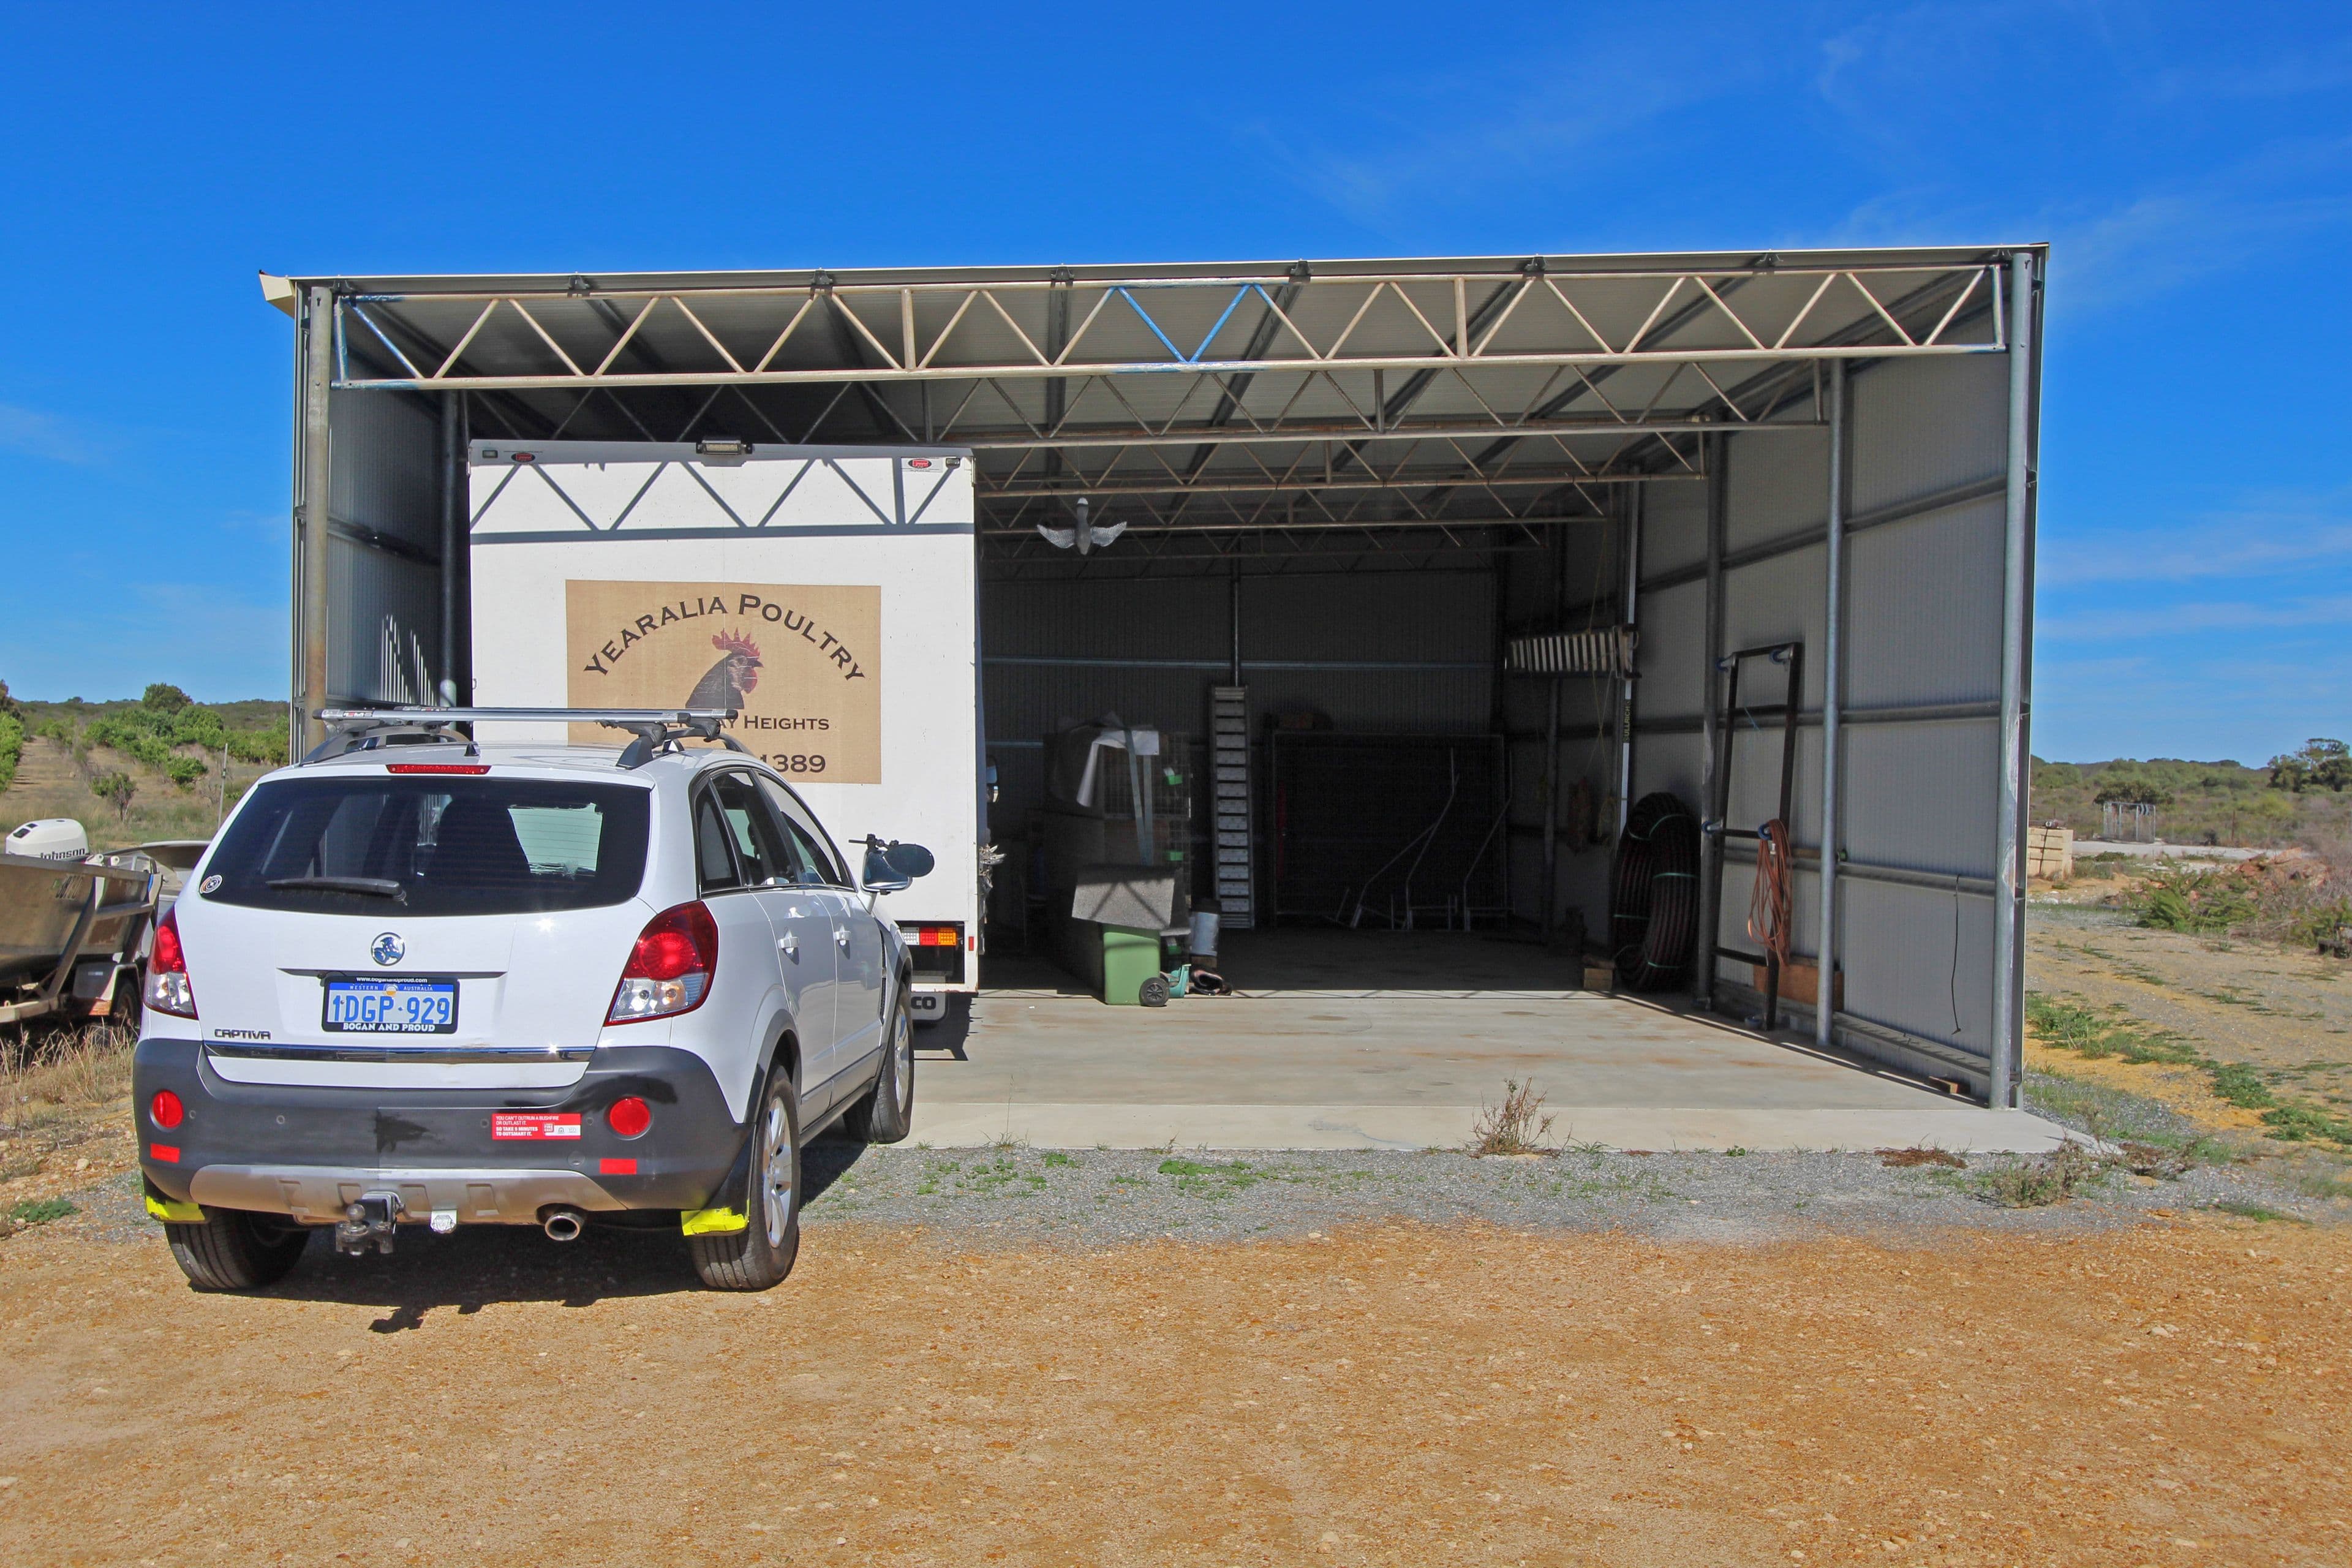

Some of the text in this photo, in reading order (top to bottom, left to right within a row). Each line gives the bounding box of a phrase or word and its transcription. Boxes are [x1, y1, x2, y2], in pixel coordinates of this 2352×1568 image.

[583, 594, 865, 682] YEARALIA POULTRY
[744, 715, 830, 731] HEIGHTS
[402, 1023, 435, 1032] PROUD
[214, 1029, 271, 1040] CAPTIVA
